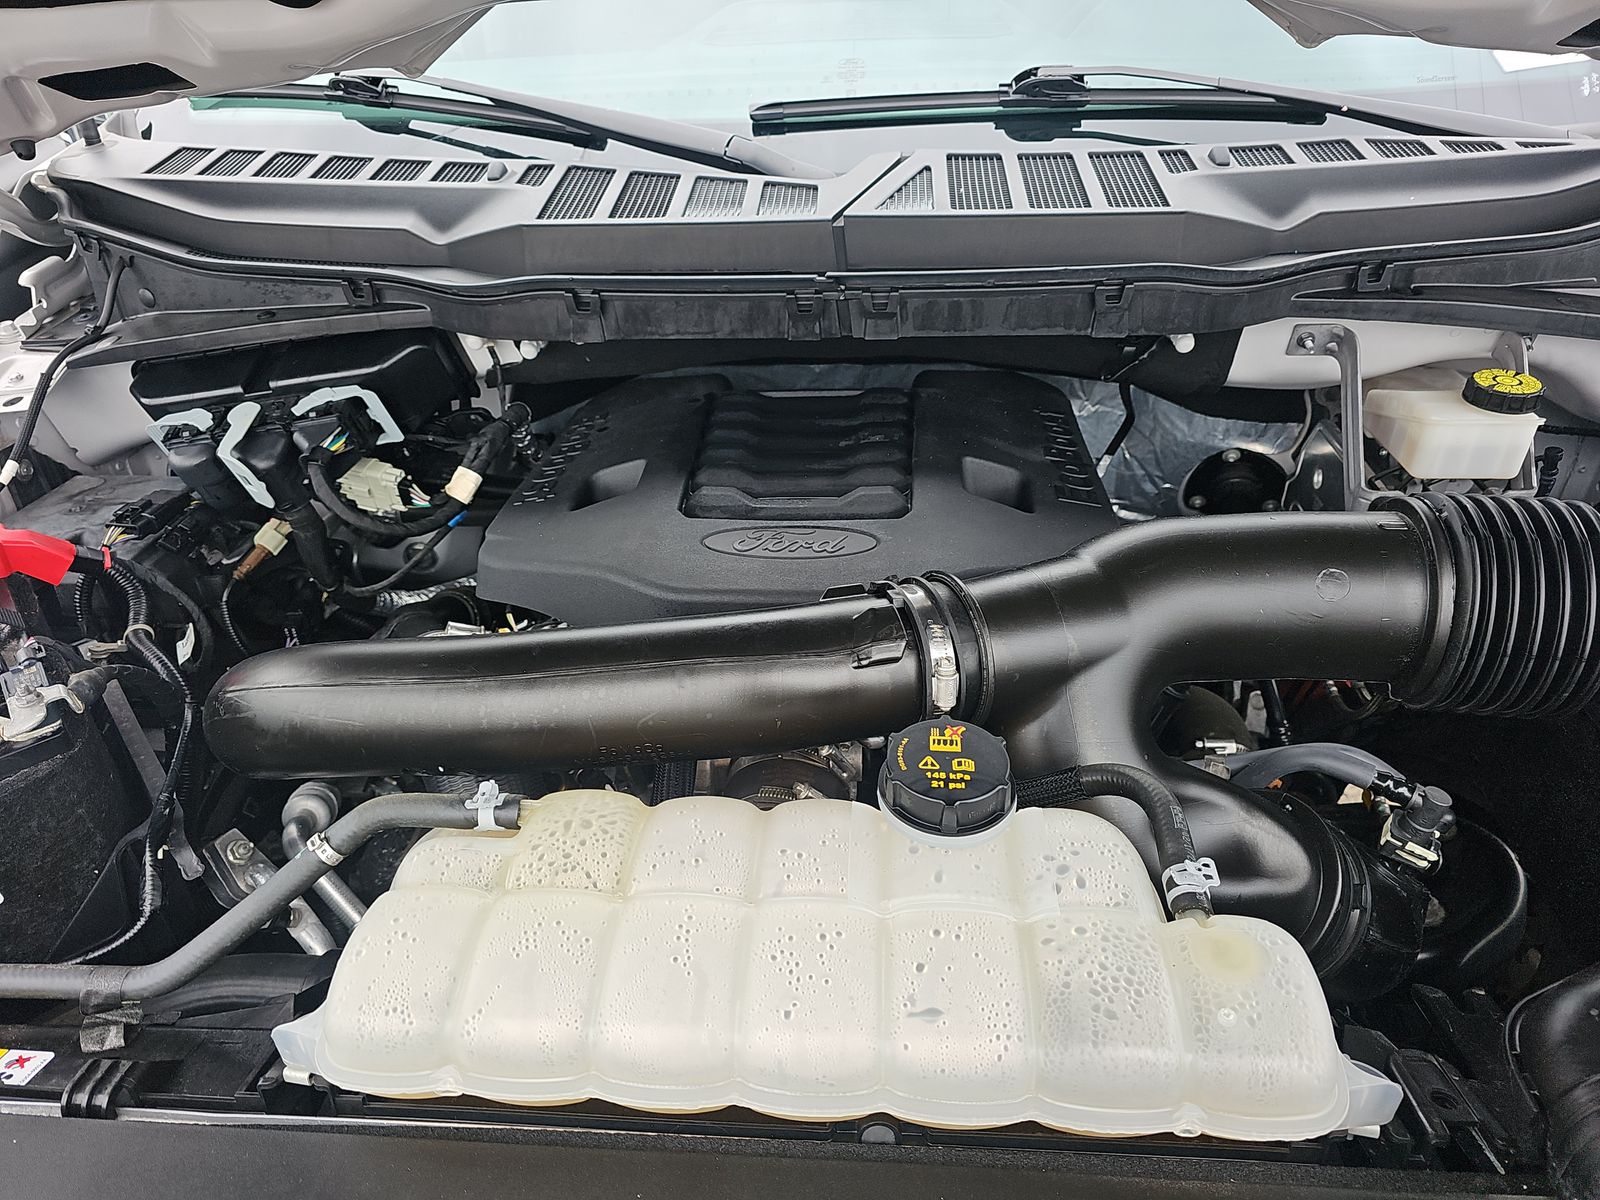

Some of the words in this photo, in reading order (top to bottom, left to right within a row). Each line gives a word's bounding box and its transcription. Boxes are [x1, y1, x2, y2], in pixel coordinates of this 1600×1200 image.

[732, 529, 849, 554] Ford
[925, 771, 947, 780] 145
[949, 771, 971, 780] kPa
[930, 780, 945, 788] 21
[948, 780, 966, 790] psi
